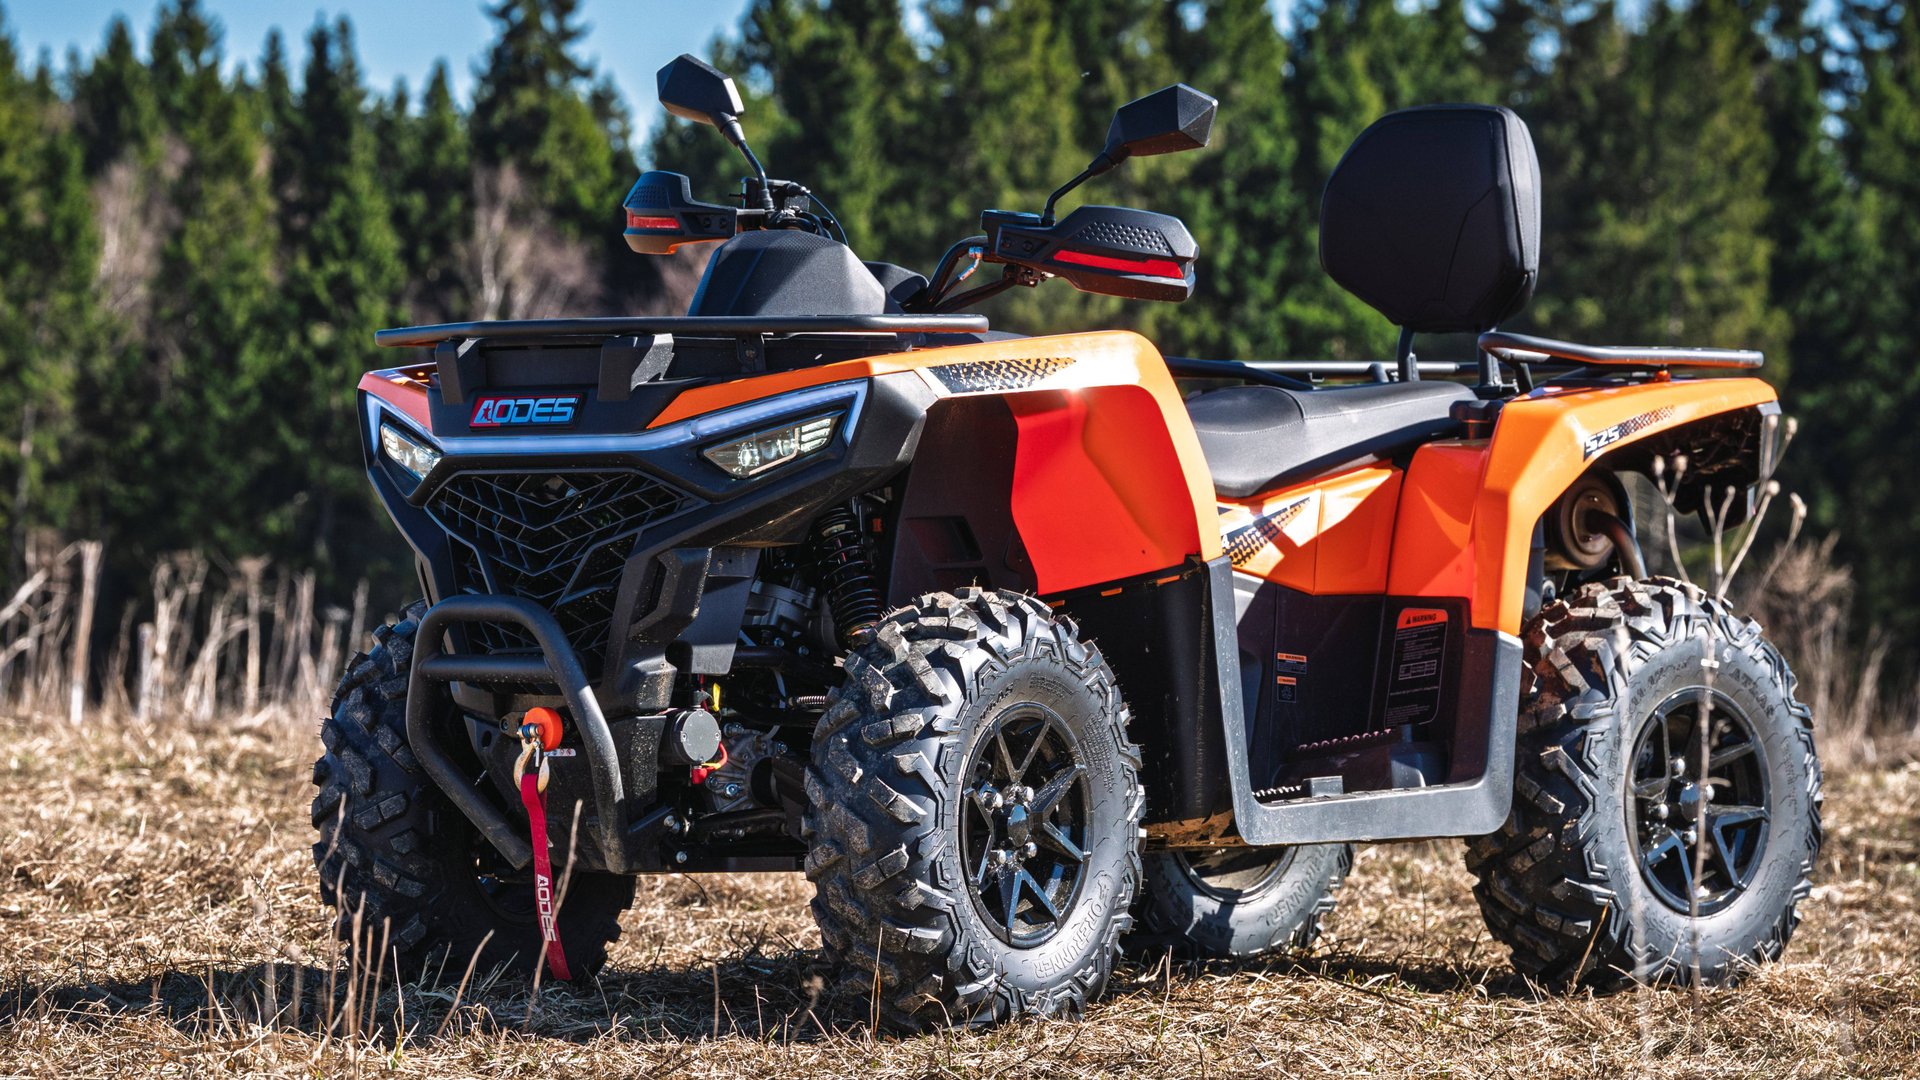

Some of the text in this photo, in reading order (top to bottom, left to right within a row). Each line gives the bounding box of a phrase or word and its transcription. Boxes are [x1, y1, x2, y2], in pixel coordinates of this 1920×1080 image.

[473, 397, 578, 424] AODES
[1585, 425, 1620, 453] 525
[536, 873, 557, 942] AODES
[1034, 872, 1113, 979] FORERUNNER
